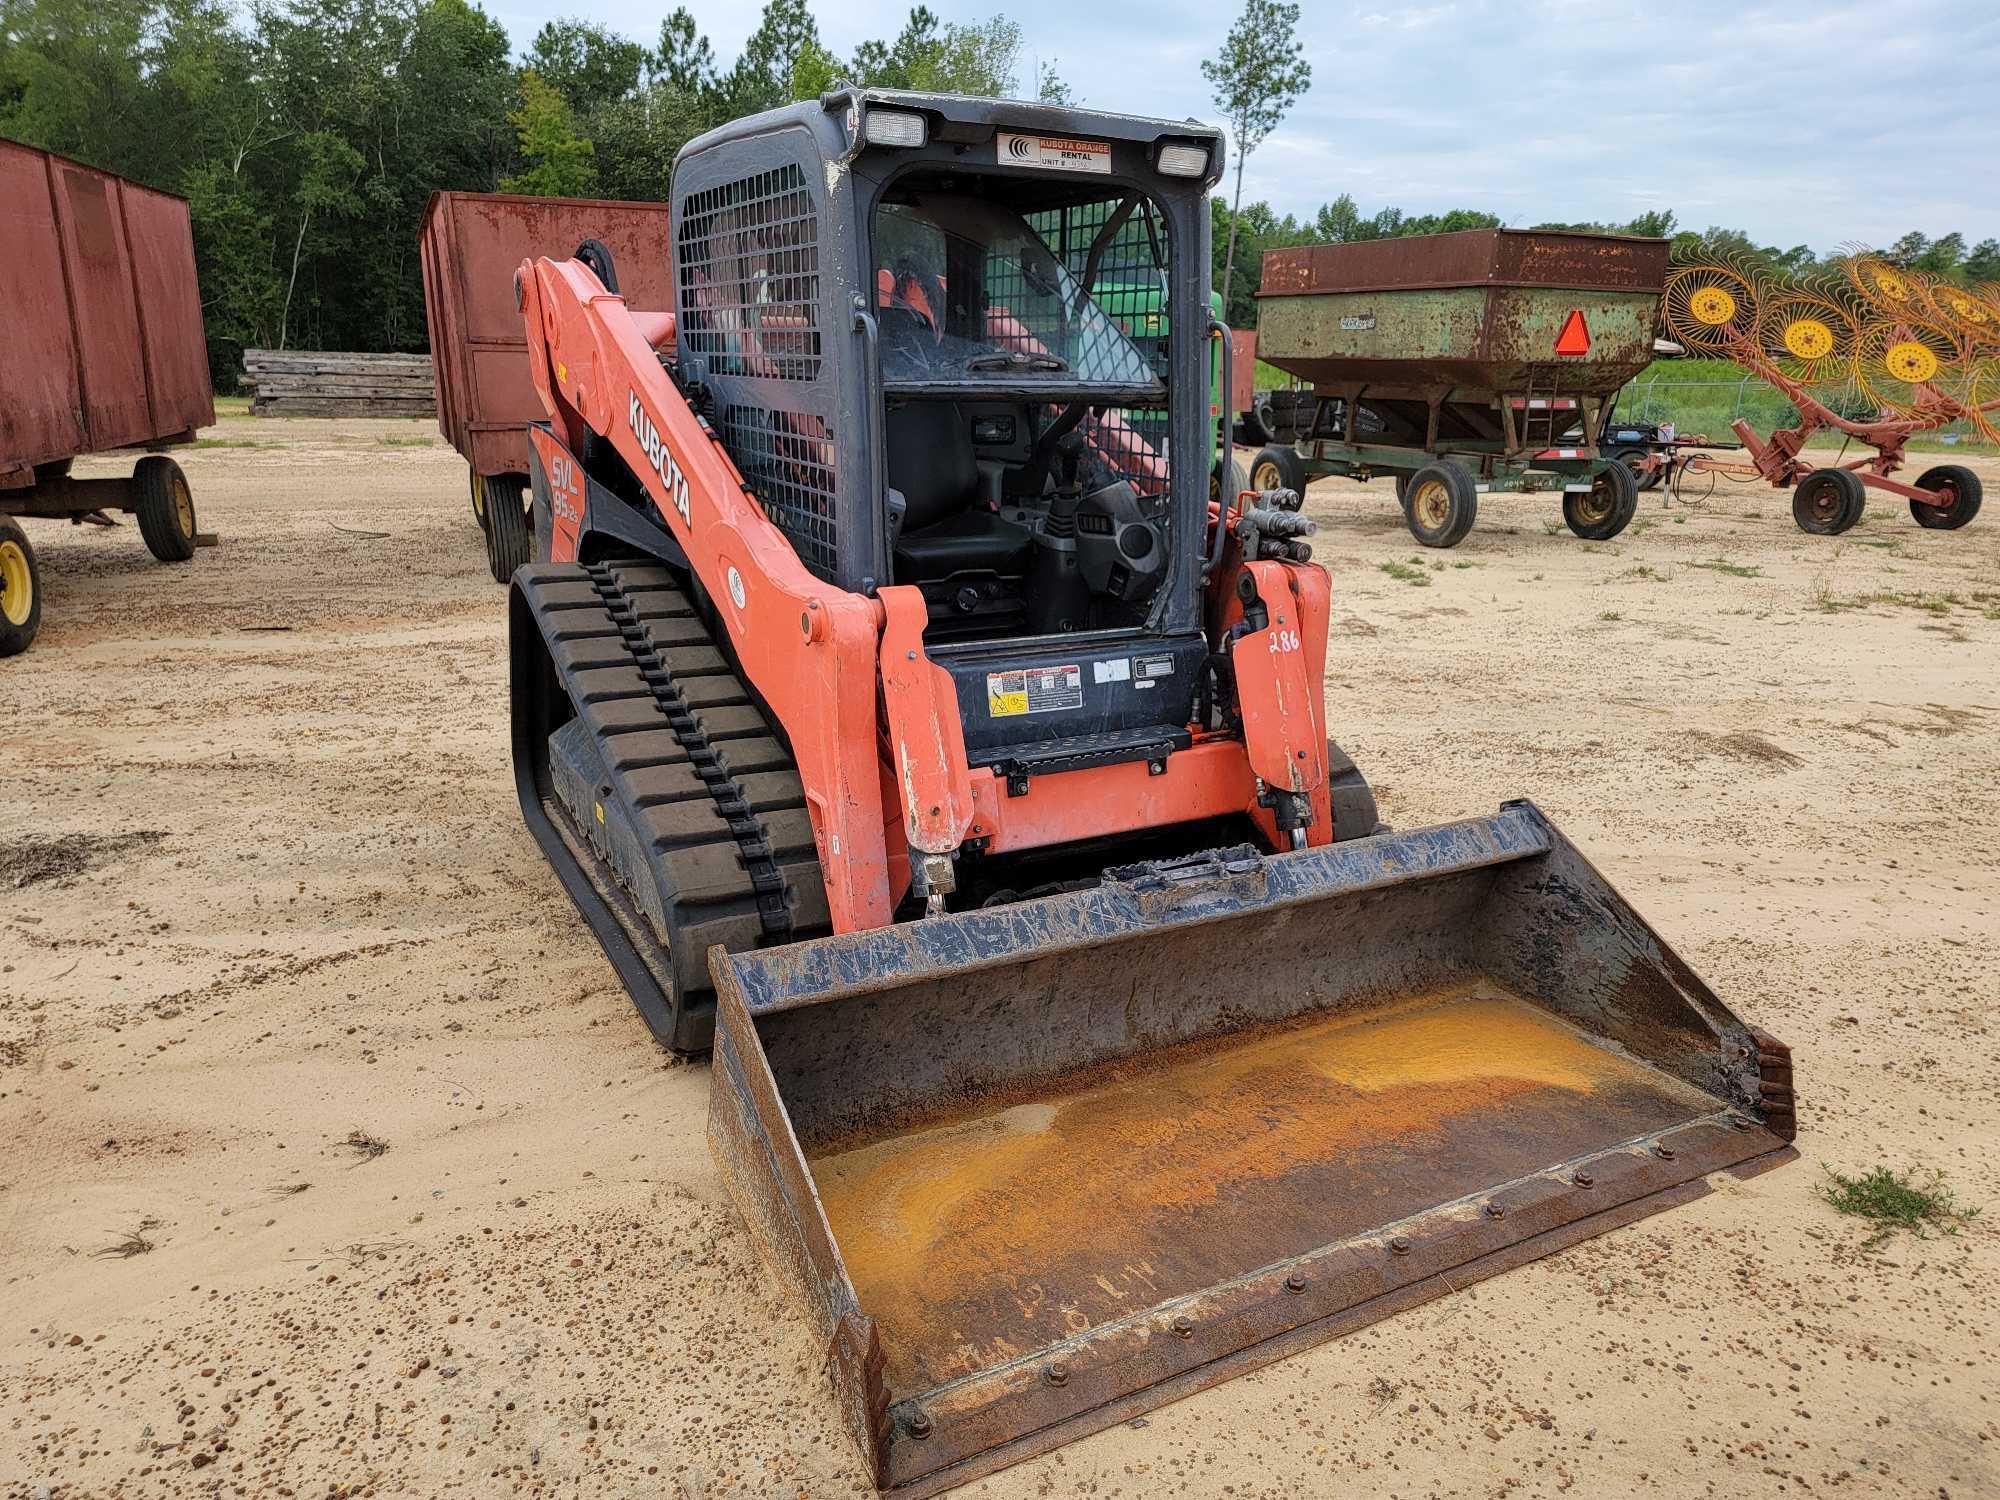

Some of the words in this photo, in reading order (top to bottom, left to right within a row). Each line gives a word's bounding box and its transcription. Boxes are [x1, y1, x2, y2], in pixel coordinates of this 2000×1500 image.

[1040, 140, 1074, 151] KUBOTA
[1075, 143, 1109, 154] ORANGE
[1061, 151, 1092, 161] RENTAL
[1042, 158, 1059, 166] UNIT
[629, 388, 691, 529] KUBOTA
[552, 455, 578, 496] SVL
[1269, 630, 1300, 653] 286
